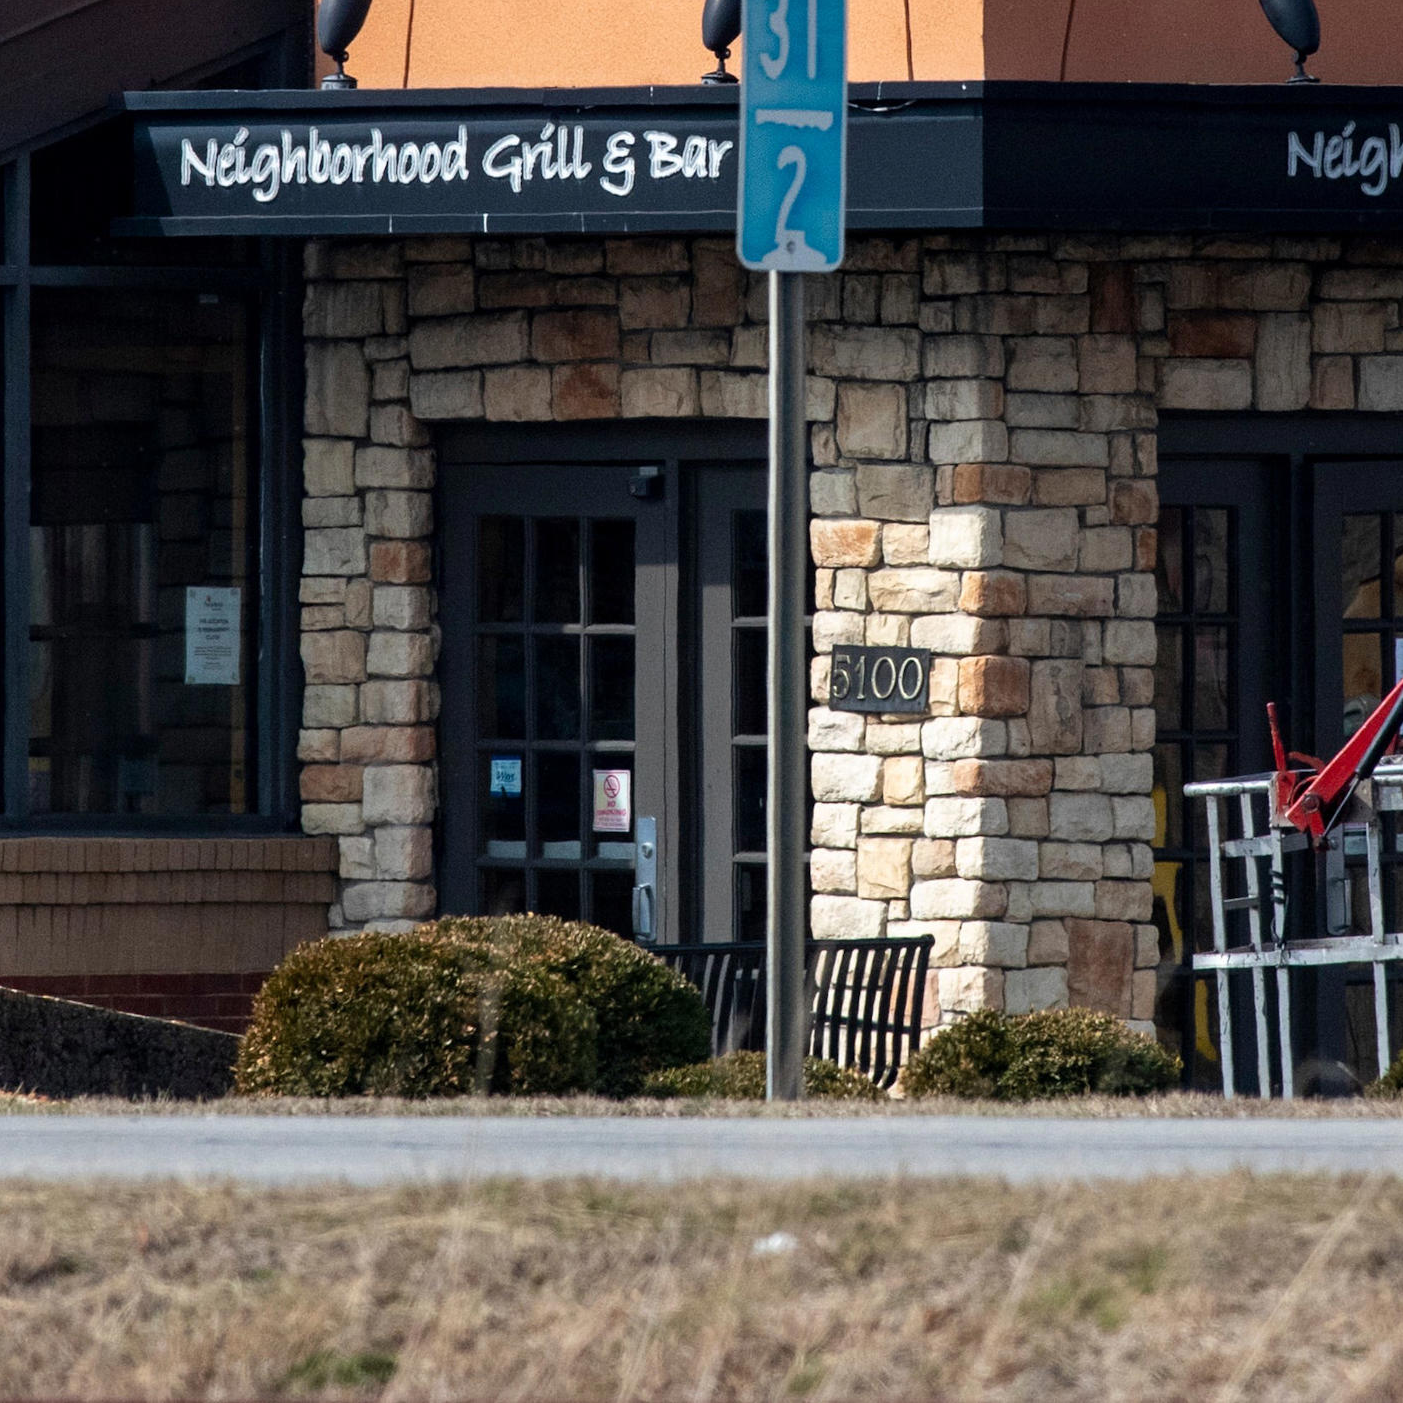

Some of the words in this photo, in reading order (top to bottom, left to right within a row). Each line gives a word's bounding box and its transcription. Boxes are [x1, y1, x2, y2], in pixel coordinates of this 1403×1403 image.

[180, 124, 470, 203] Neighborhood
[481, 122, 594, 195] Grill
[599, 130, 636, 198] &
[642, 129, 735, 180] Bar
[774, 144, 808, 246] 2
[832, 654, 924, 701] 5100
